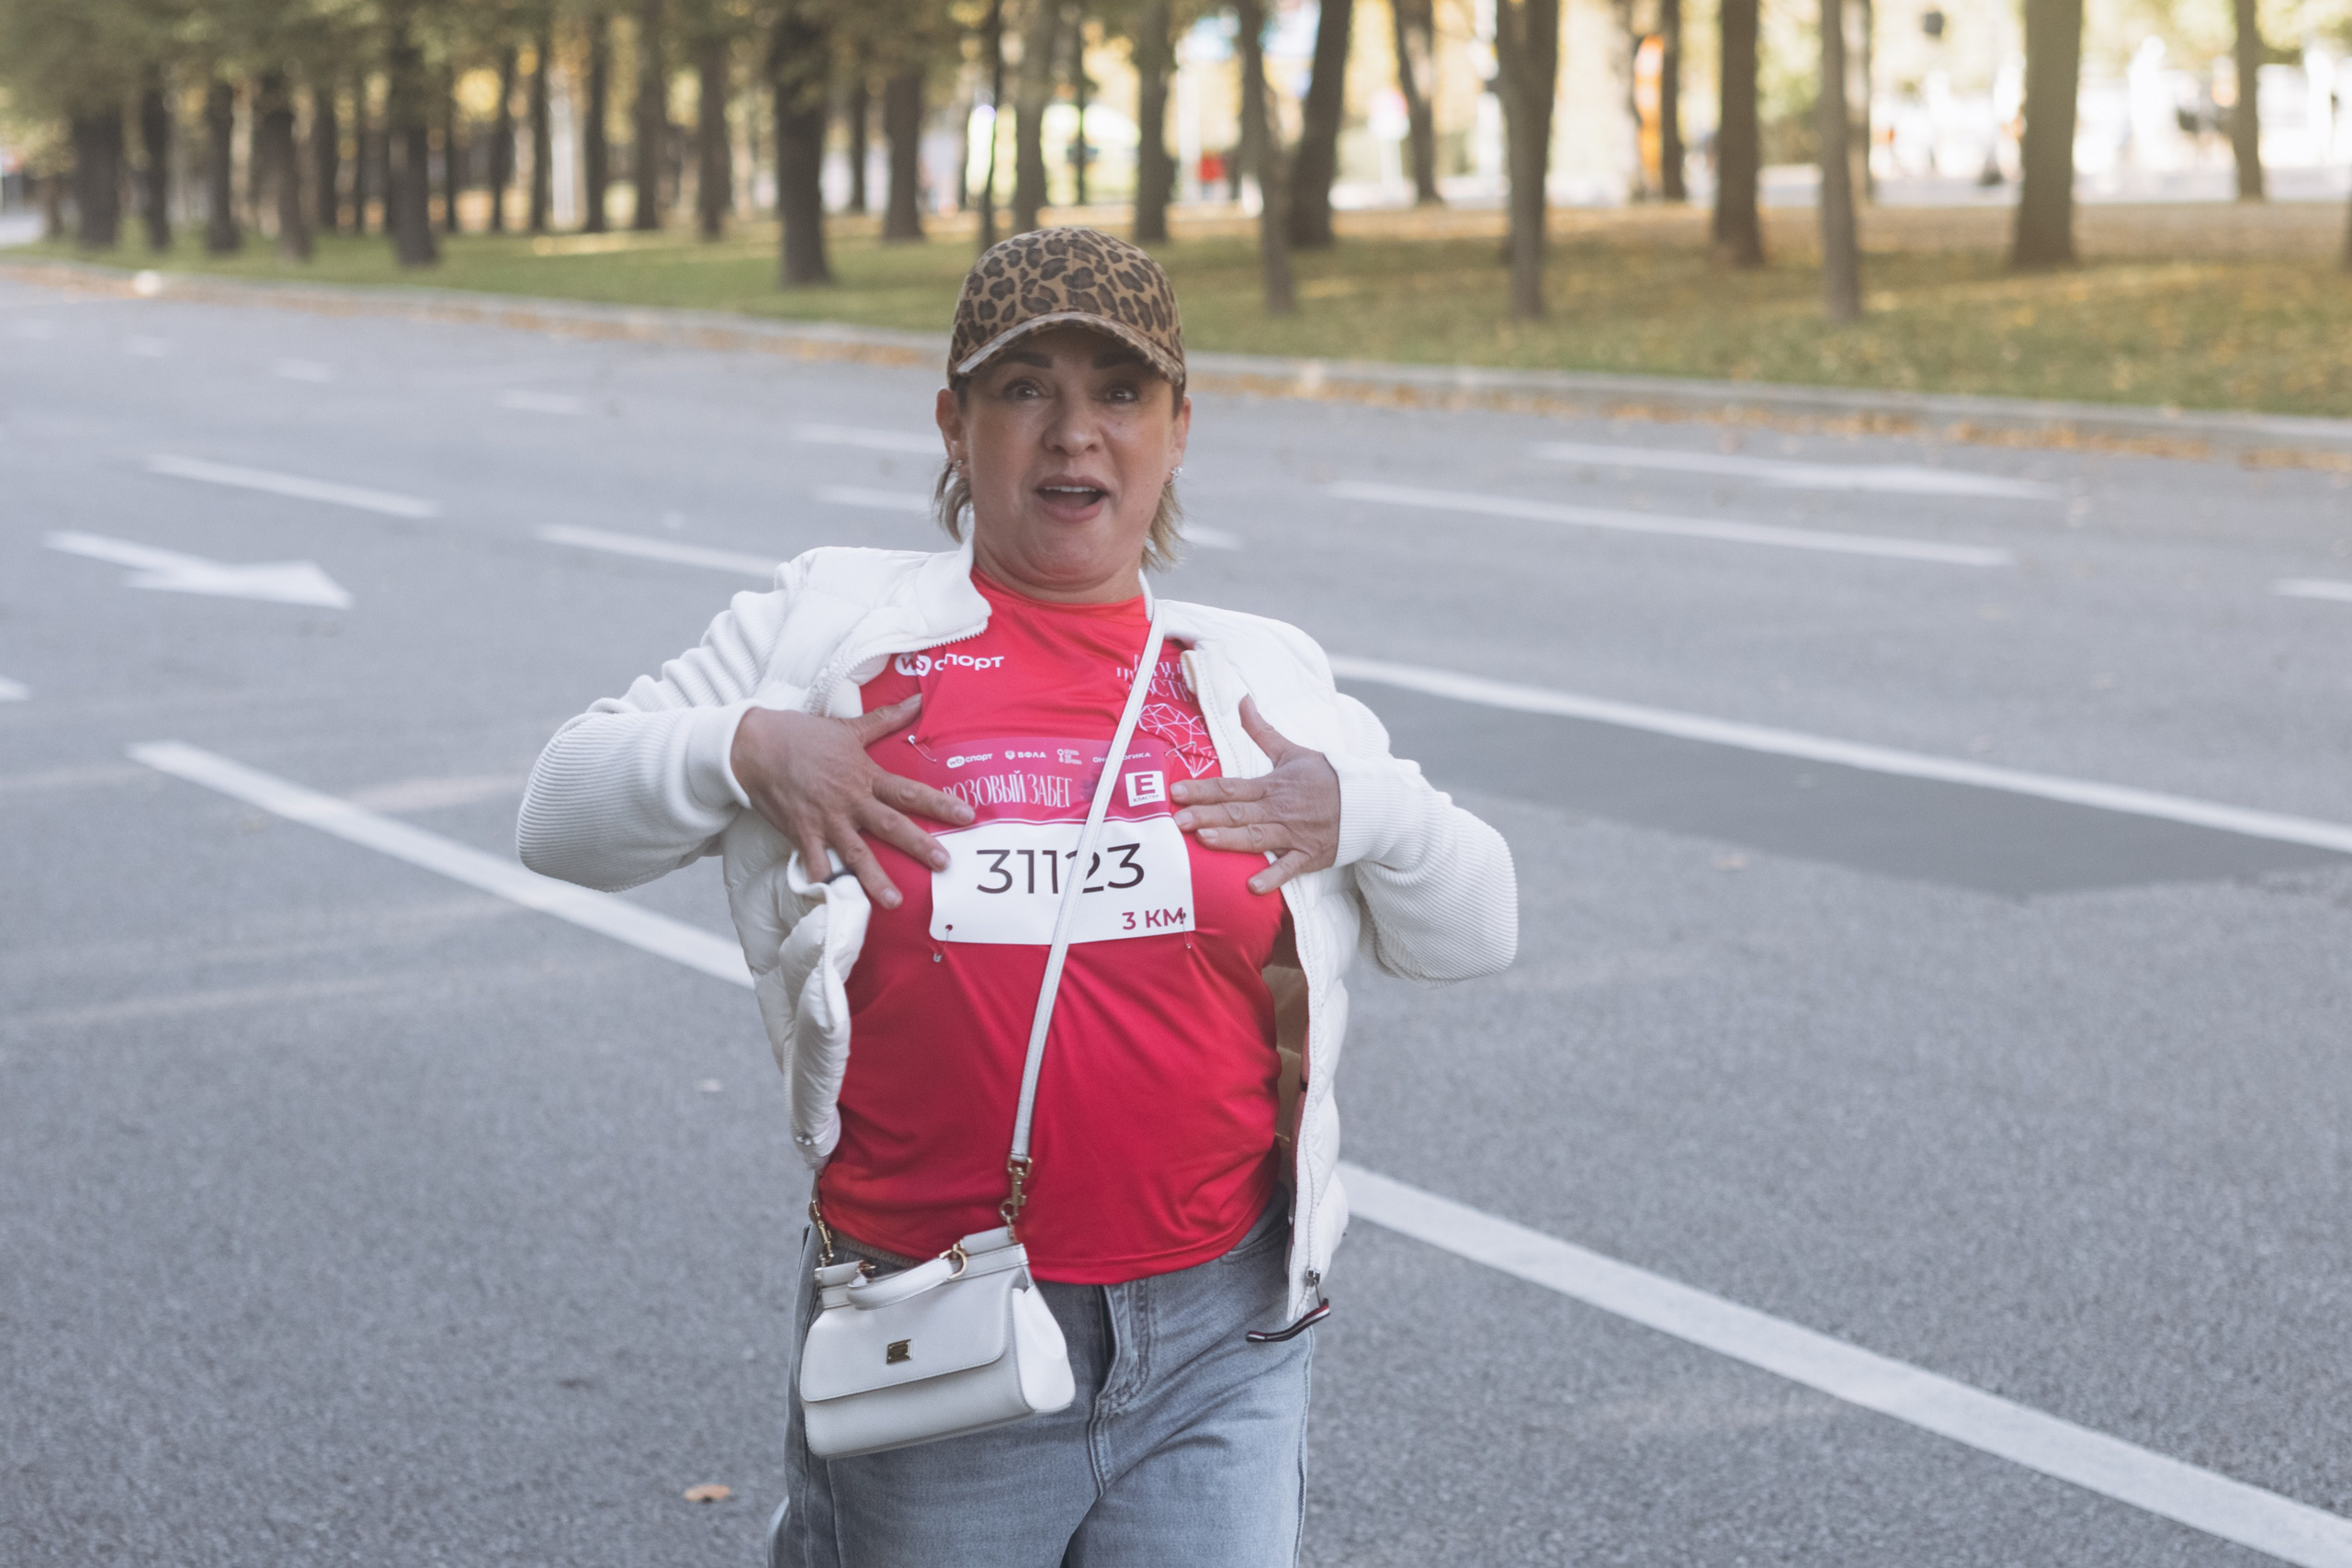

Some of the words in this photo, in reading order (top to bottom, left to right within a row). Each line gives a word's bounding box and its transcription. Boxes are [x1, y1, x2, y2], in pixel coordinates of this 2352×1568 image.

[934, 653, 1004, 671] спорт
[965, 753, 992, 763] спорт
[1092, 752, 1150, 763] ОНОГИКА
[1027, 774, 1072, 807] ЗАБЕГ
[976, 843, 1144, 894] 31123
[1122, 911, 1136, 930] 3
[1145, 908, 1184, 928] КМ
